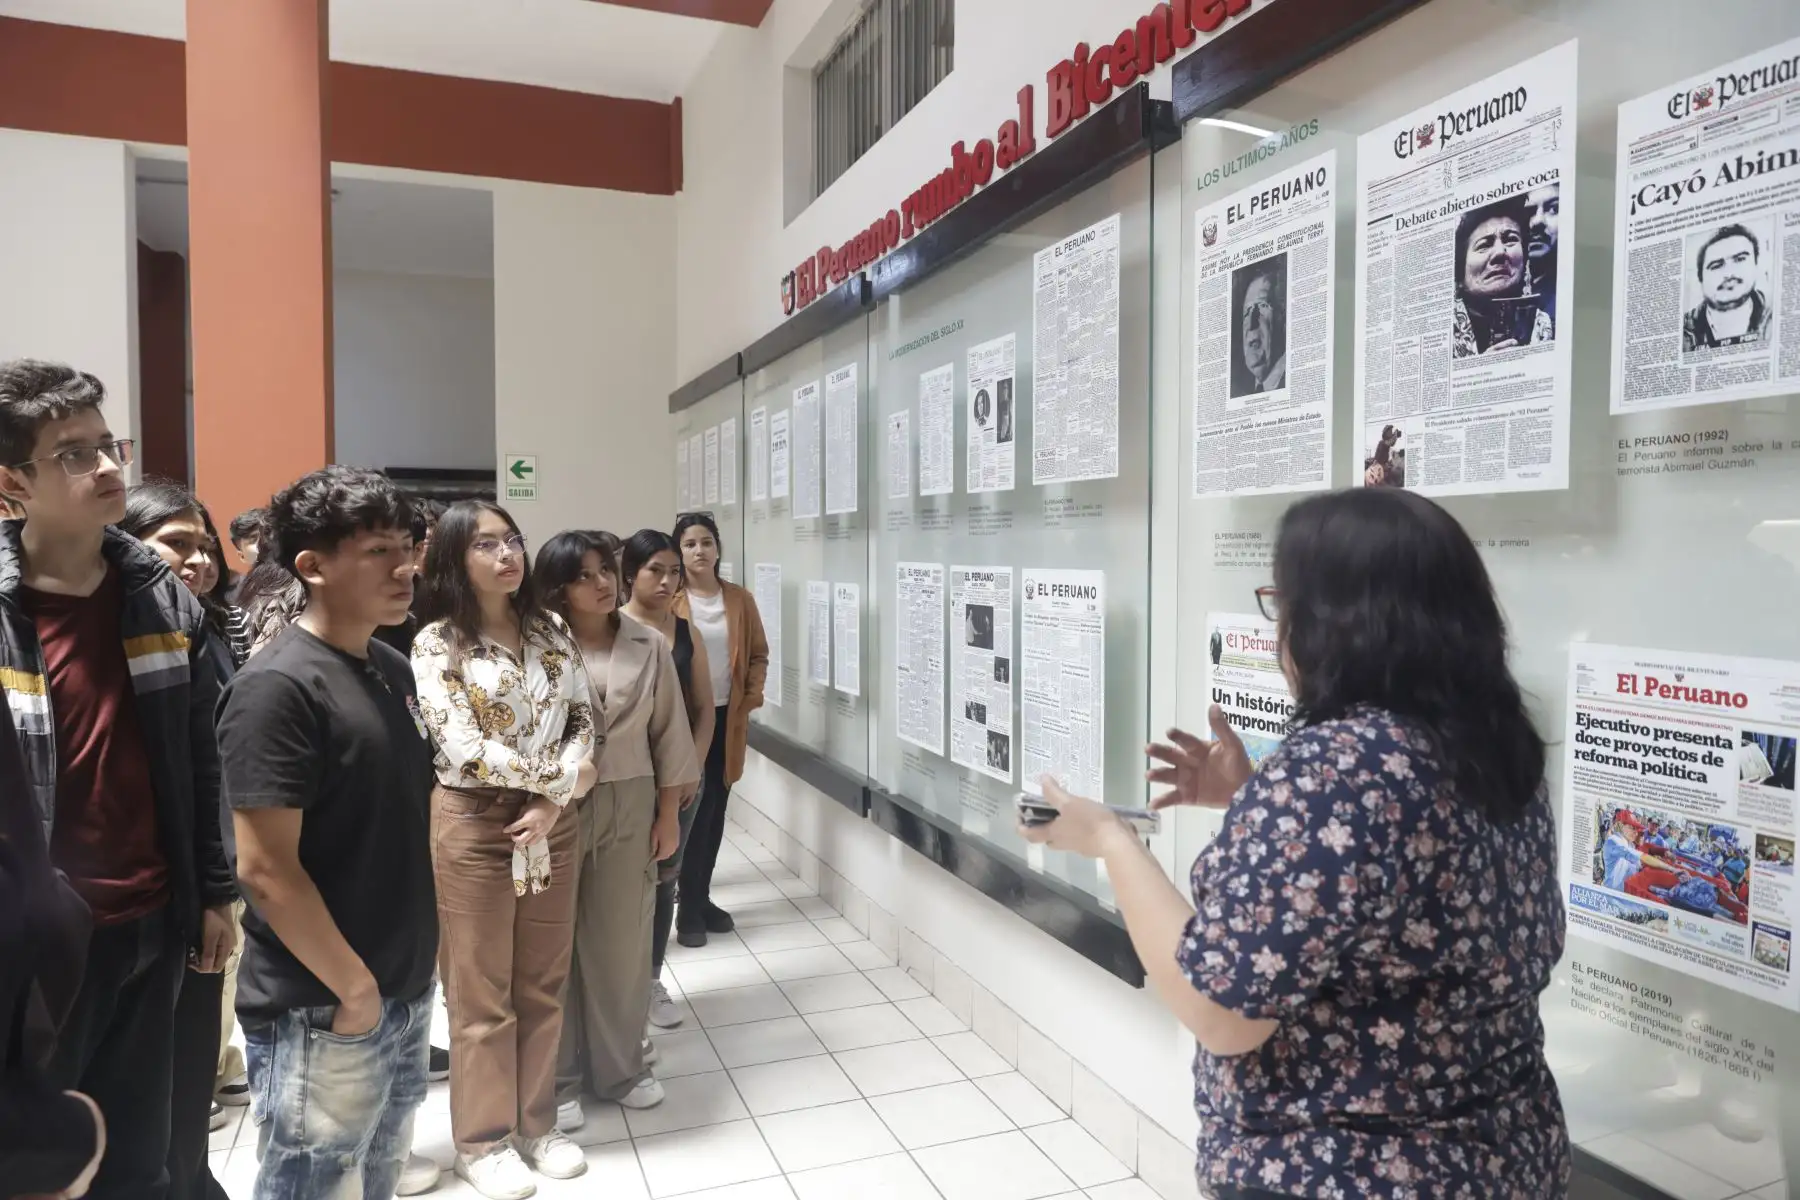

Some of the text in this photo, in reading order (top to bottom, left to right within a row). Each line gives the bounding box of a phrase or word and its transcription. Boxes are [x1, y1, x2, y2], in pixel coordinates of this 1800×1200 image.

[1668, 89, 1690, 119] El
[1394, 127, 1414, 159] El
[1437, 86, 1527, 151] Peruano
[1197, 118, 1319, 191] LOS ULTIMOS AÑOS
[796, 256, 816, 309] El
[817, 209, 900, 295] Peruano
[901, 138, 994, 239] rumbo
[996, 84, 1036, 169] al
[1227, 203, 1245, 225] EL
[1250, 167, 1326, 215] PERUANO
[1631, 168, 1706, 215] ¡Cayó
[1712, 148, 1800, 187] Abim
[1395, 168, 1559, 231] Debate abierto sobre coca
[1055, 230, 1096, 257] EL PERUANO
[1201, 221, 1325, 272] ASUME HOY LA PRESIDENCIA CONSTITUCIONAL
[1247, 247, 1273, 261] FERNANDO
[1277, 236, 1304, 251] BELAUNDE
[1307, 229, 1324, 240] TERRY
[1618, 430, 1729, 449] EL PERUANO (1992)
[1618, 453, 1627, 462] El
[1634, 451, 1676, 461] Peruano
[1683, 446, 1724, 456] informa
[1731, 442, 1764, 453] sobre
[1772, 439, 1782, 449] la
[1617, 463, 1660, 476] terrorista
[1662, 460, 1704, 472] Abimael
[509, 488, 534, 497] SALIDA
[965, 572, 994, 582] EL PERUANO
[1038, 583, 1096, 599] EL PERUANO
[1226, 632, 1237, 648] El
[1212, 688, 1231, 706] Un
[1616, 673, 1638, 694] El
[1644, 676, 1748, 708] Peruano
[1220, 712, 1294, 735] ompromis
[1576, 711, 1733, 750] Ejecutivo presenta
[1574, 748, 1707, 784] reforma política
[1575, 730, 1724, 768] doce proyectos de
[1571, 886, 1608, 904] ALIANZA
[1571, 893, 1587, 905] POR
[1588, 899, 1598, 908] EL
[1572, 961, 1673, 1007] EL PERUANO (2019)
[1570, 998, 1597, 1017] Diario
[1599, 1009, 1628, 1029] Oficial
[1630, 1021, 1640, 1034] El
[1642, 1027, 1685, 1051] Peruano
[1571, 973, 1775, 1059] Se declara Patrimonio Cultural de la
[1571, 986, 1775, 1076] Nación a los ejemplares del siglo XIX del
